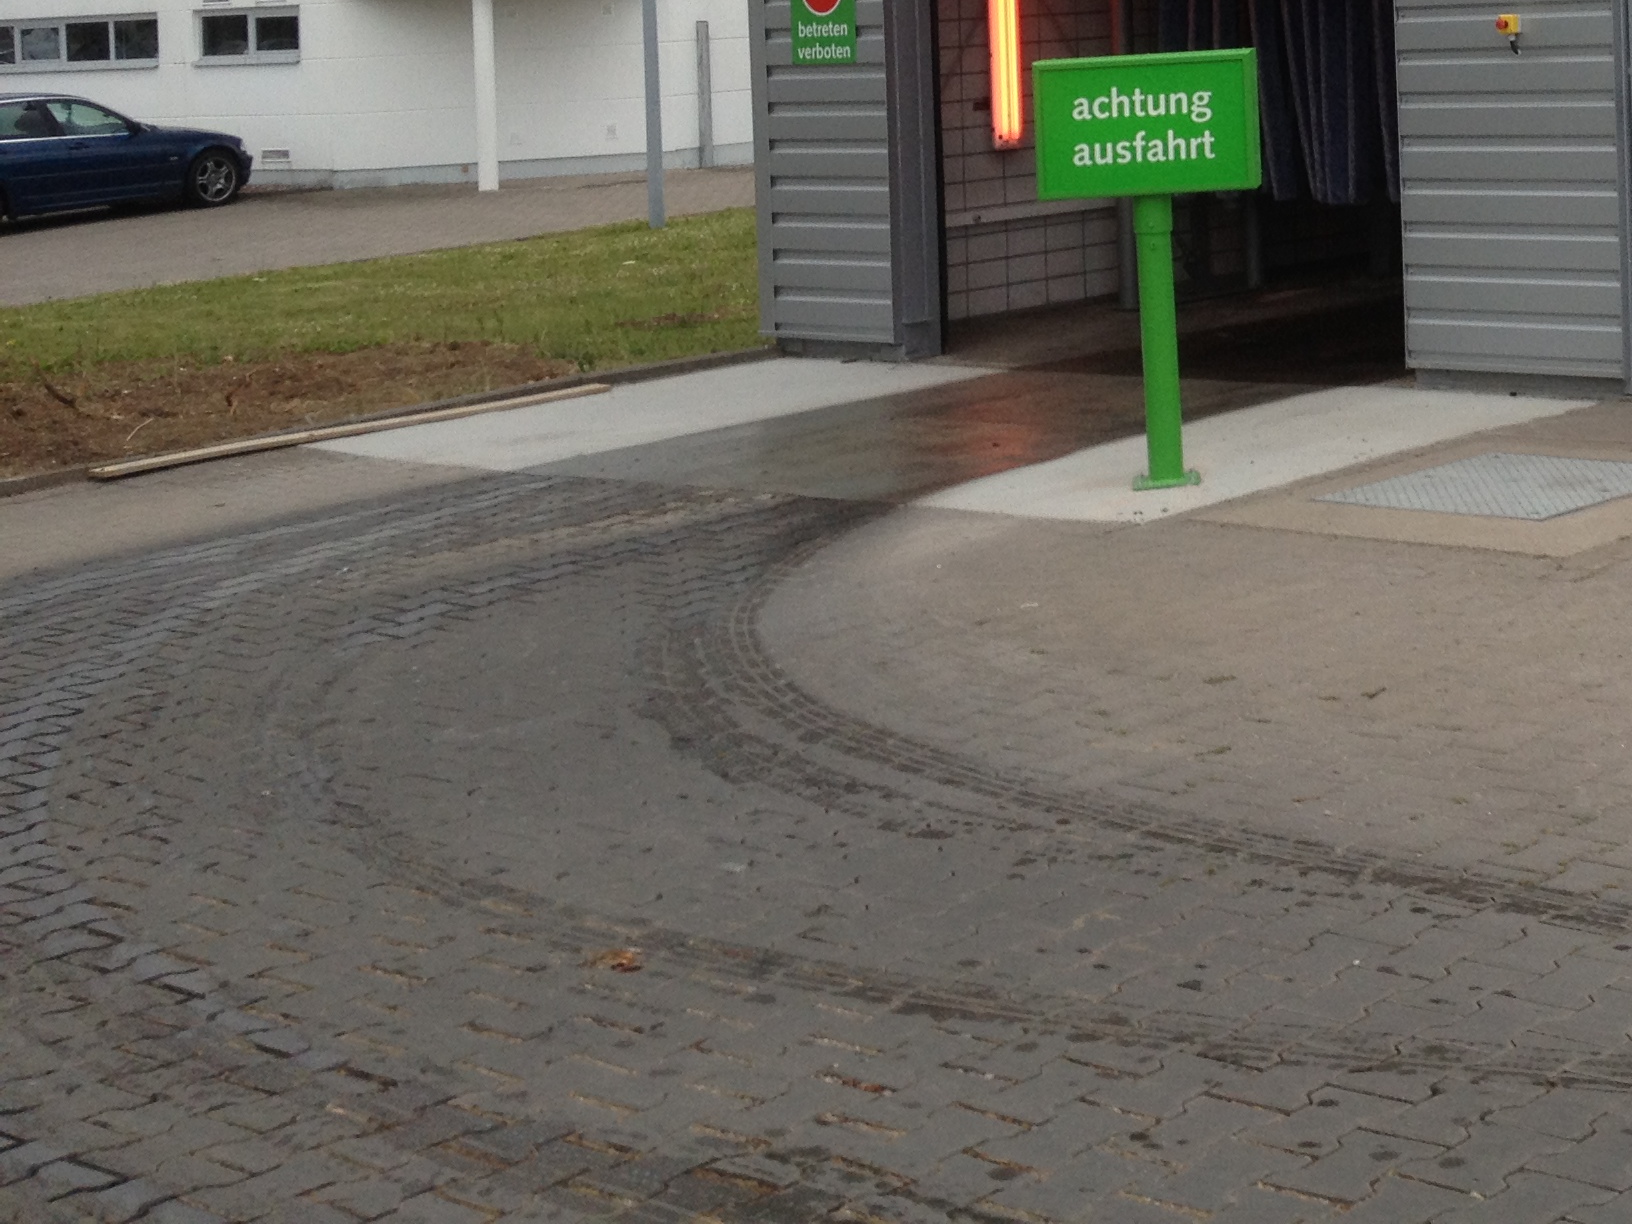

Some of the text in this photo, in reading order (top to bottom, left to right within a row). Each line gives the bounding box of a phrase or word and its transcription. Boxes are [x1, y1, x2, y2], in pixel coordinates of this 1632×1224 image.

[797, 20, 849, 38] betreten
[796, 42, 852, 60] verboten
[1072, 86, 1213, 123] achtung
[1072, 129, 1217, 166] ausfahrt
